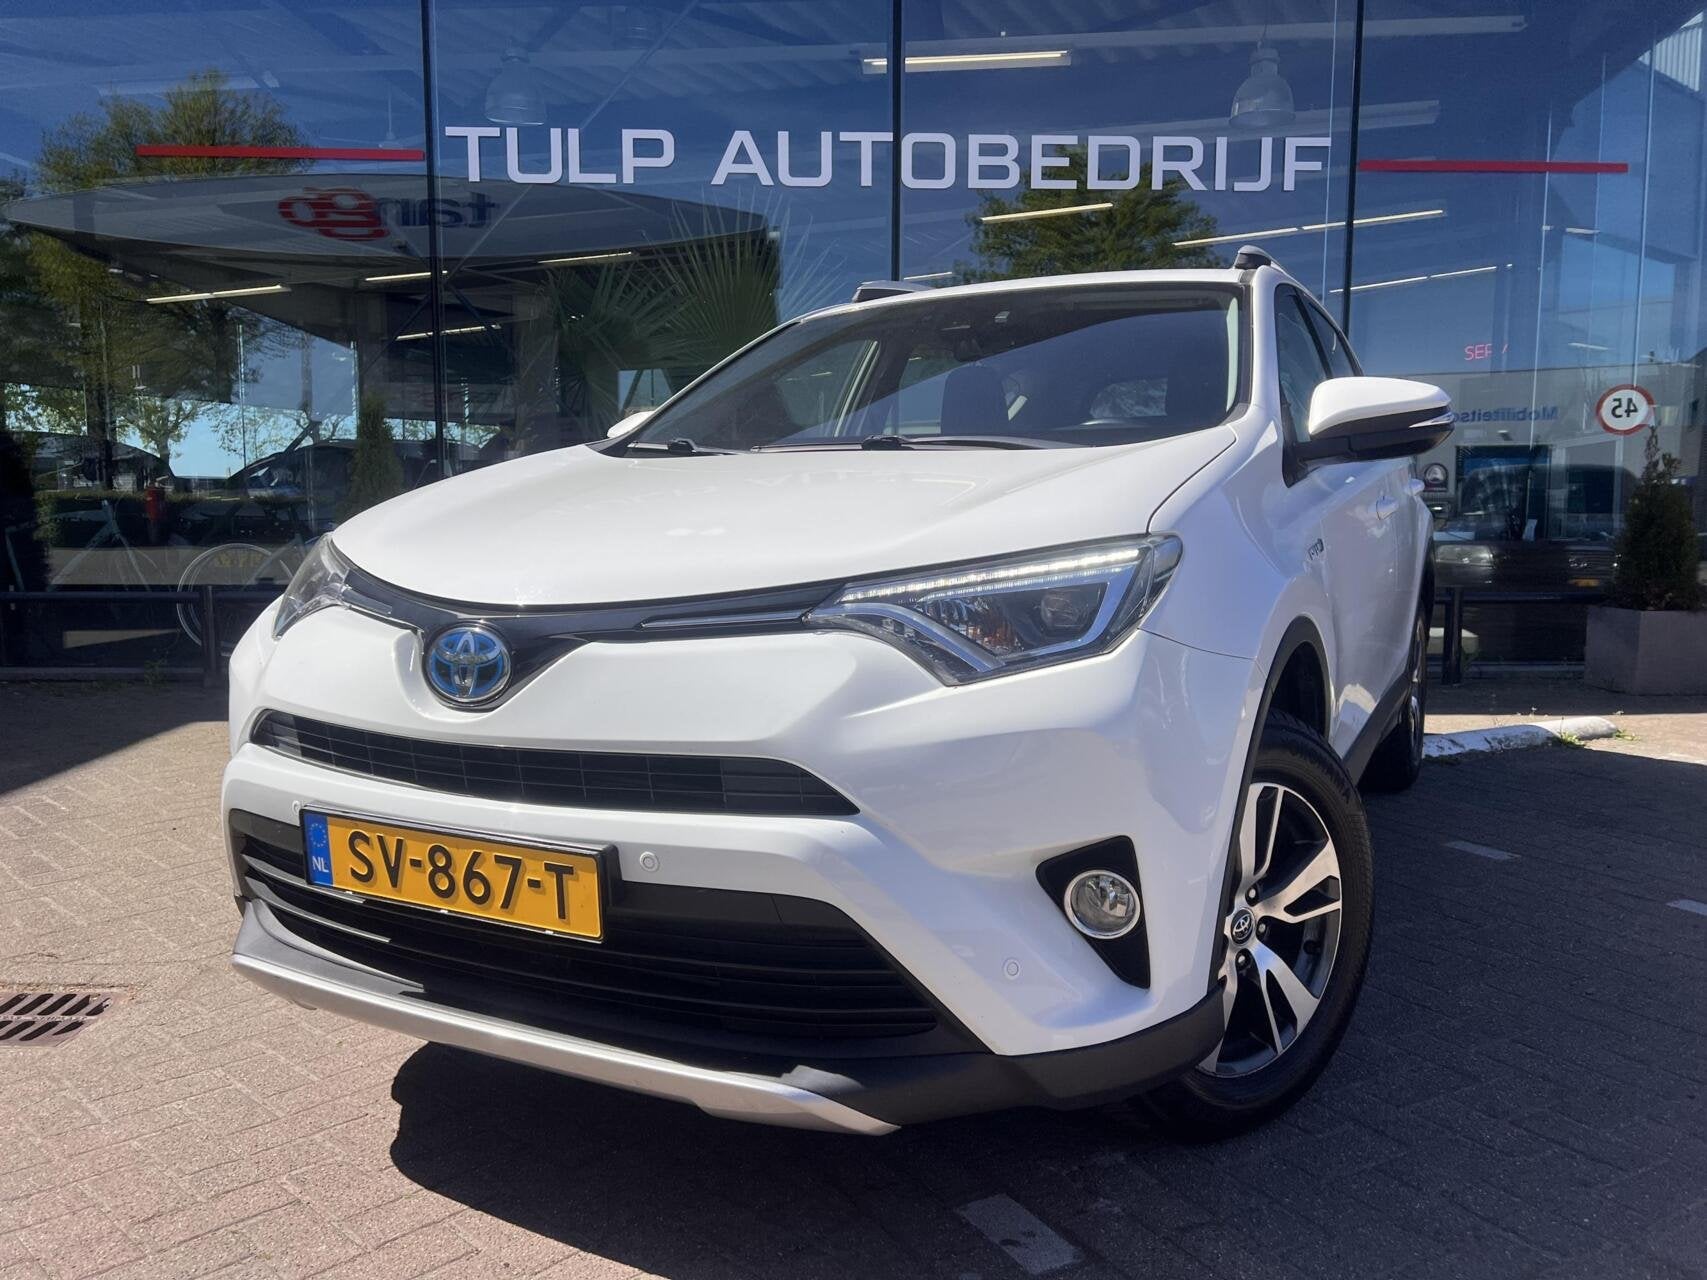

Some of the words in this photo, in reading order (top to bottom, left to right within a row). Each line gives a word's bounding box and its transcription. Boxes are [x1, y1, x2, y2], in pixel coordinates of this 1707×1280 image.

[445, 126, 675, 184] TULP
[711, 130, 1332, 191] AUTOBEDRIJF
[312, 856, 330, 874] NL
[348, 830, 575, 921] SV-867-T
